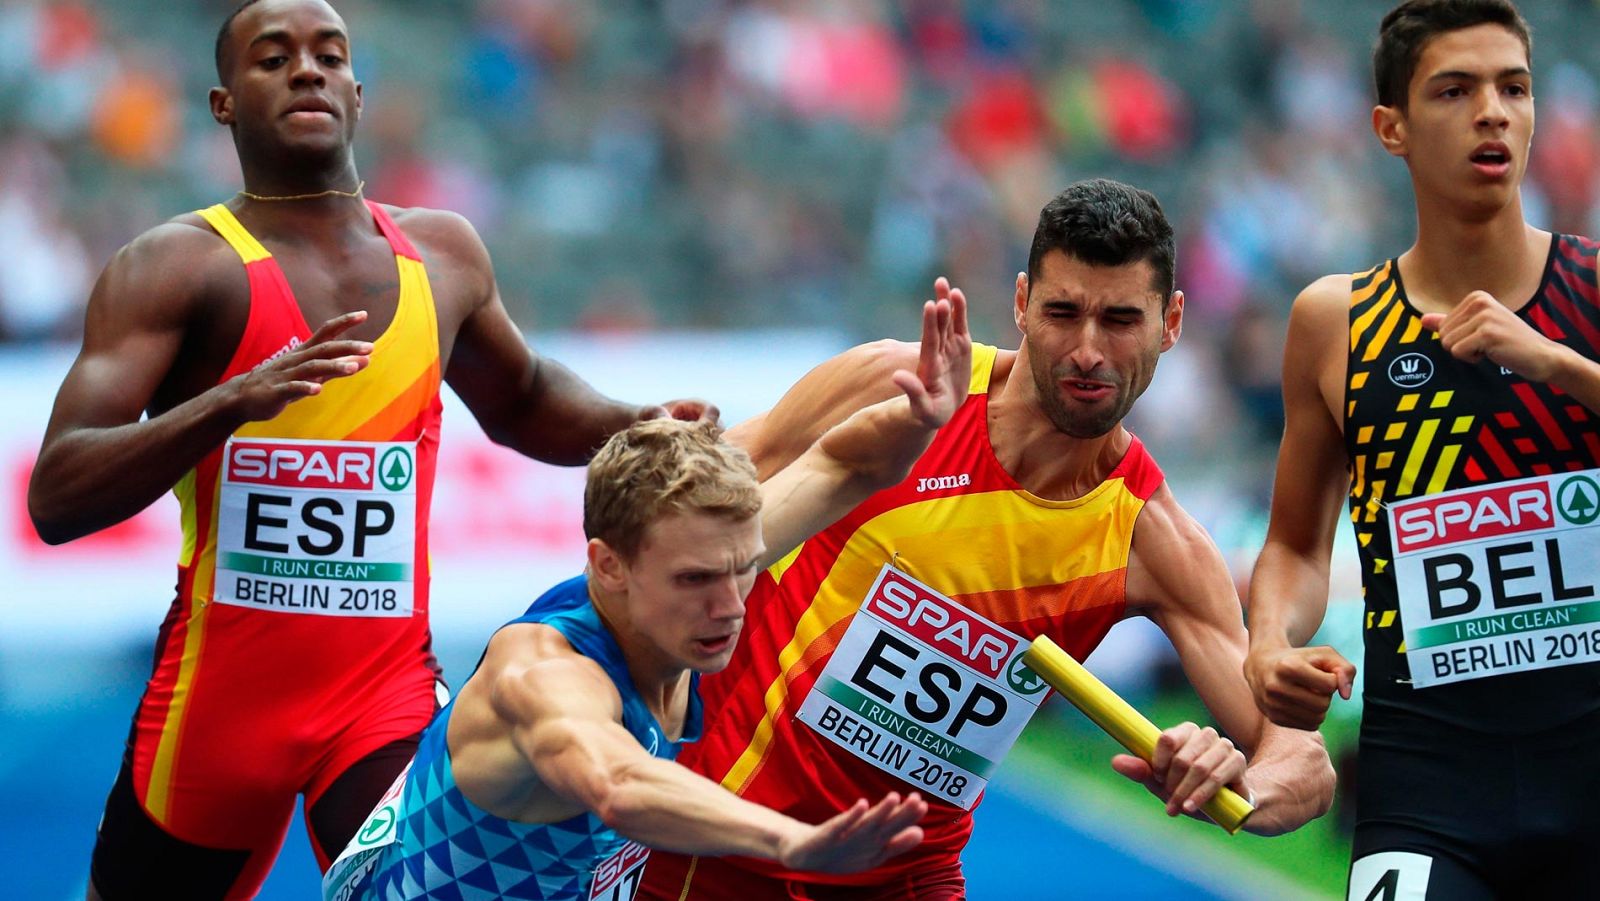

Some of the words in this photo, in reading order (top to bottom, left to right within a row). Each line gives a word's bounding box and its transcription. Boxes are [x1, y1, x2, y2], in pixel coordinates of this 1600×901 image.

[233, 448, 371, 485] SPAR
[244, 493, 395, 558] ESP
[1399, 488, 1549, 545] SPAR
[263, 559, 267, 572] I
[272, 560, 309, 576] RUN
[1423, 538, 1595, 620] BEL
[235, 577, 330, 609] BERLIN
[339, 588, 396, 611] 2018
[876, 580, 1008, 672] SPAR
[1455, 624, 1461, 639] I
[1466, 618, 1506, 637] RUN
[1432, 638, 1535, 678] BERLIN
[850, 629, 1008, 738] ESP
[858, 699, 867, 712] I
[867, 704, 902, 733] RUN
[817, 705, 911, 771] BERLIN
[910, 756, 968, 797] 2018
